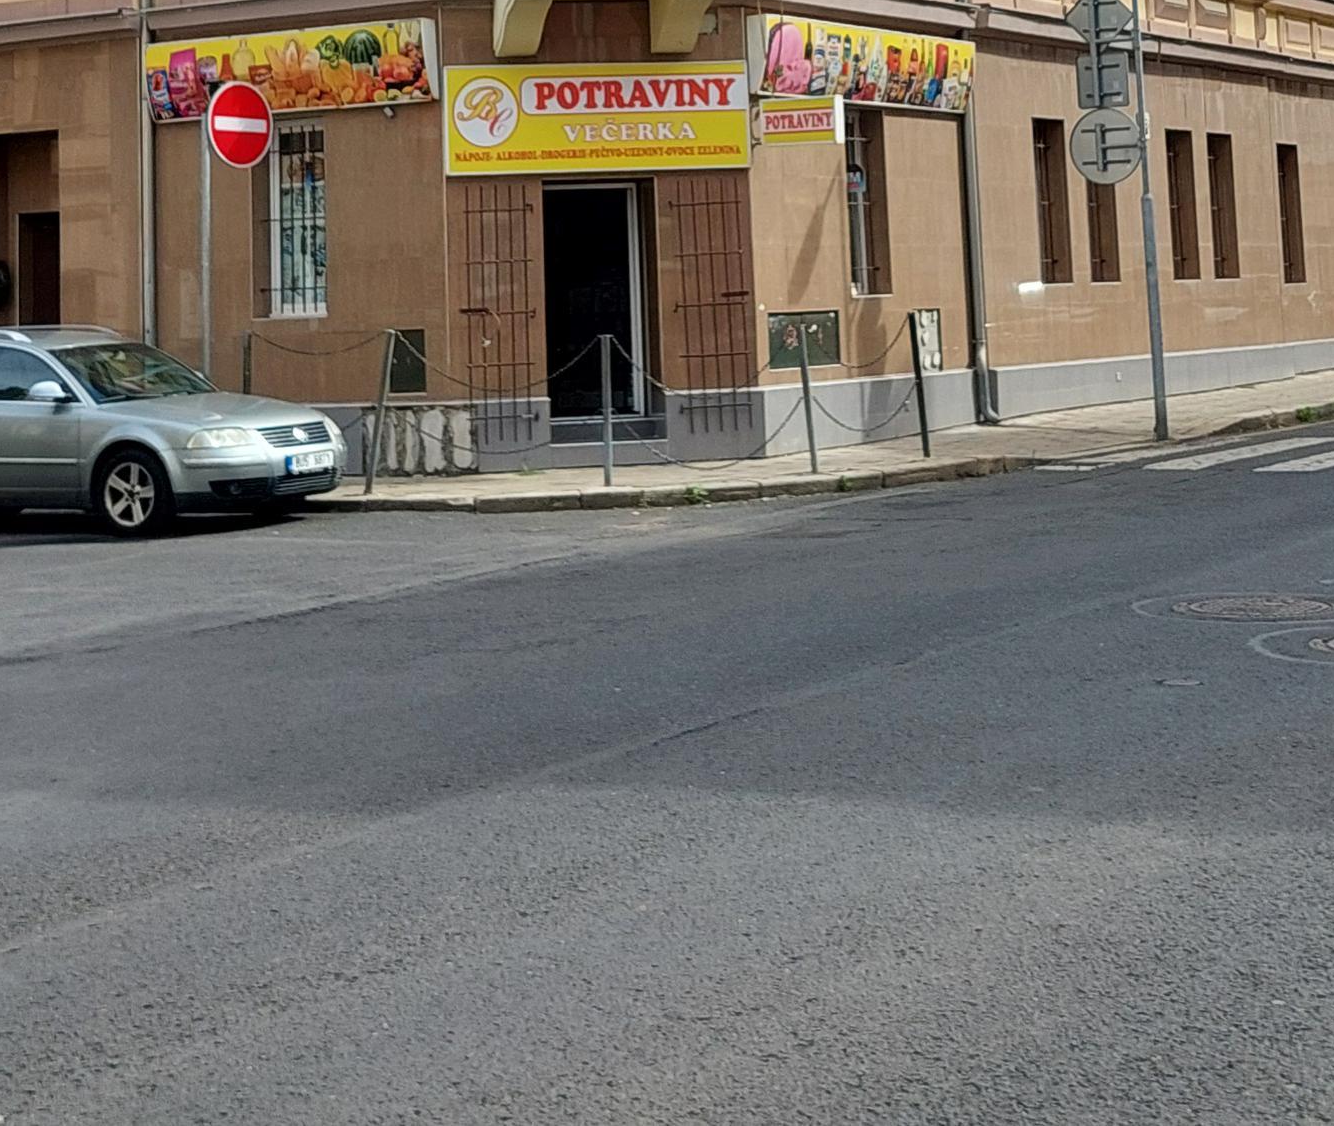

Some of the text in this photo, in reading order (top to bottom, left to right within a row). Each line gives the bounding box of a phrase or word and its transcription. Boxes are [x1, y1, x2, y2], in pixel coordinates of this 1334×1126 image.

[534, 77, 736, 111] POTRAVINY
[562, 117, 696, 143] VEČERKA
[764, 112, 833, 131] POTRAVINY
